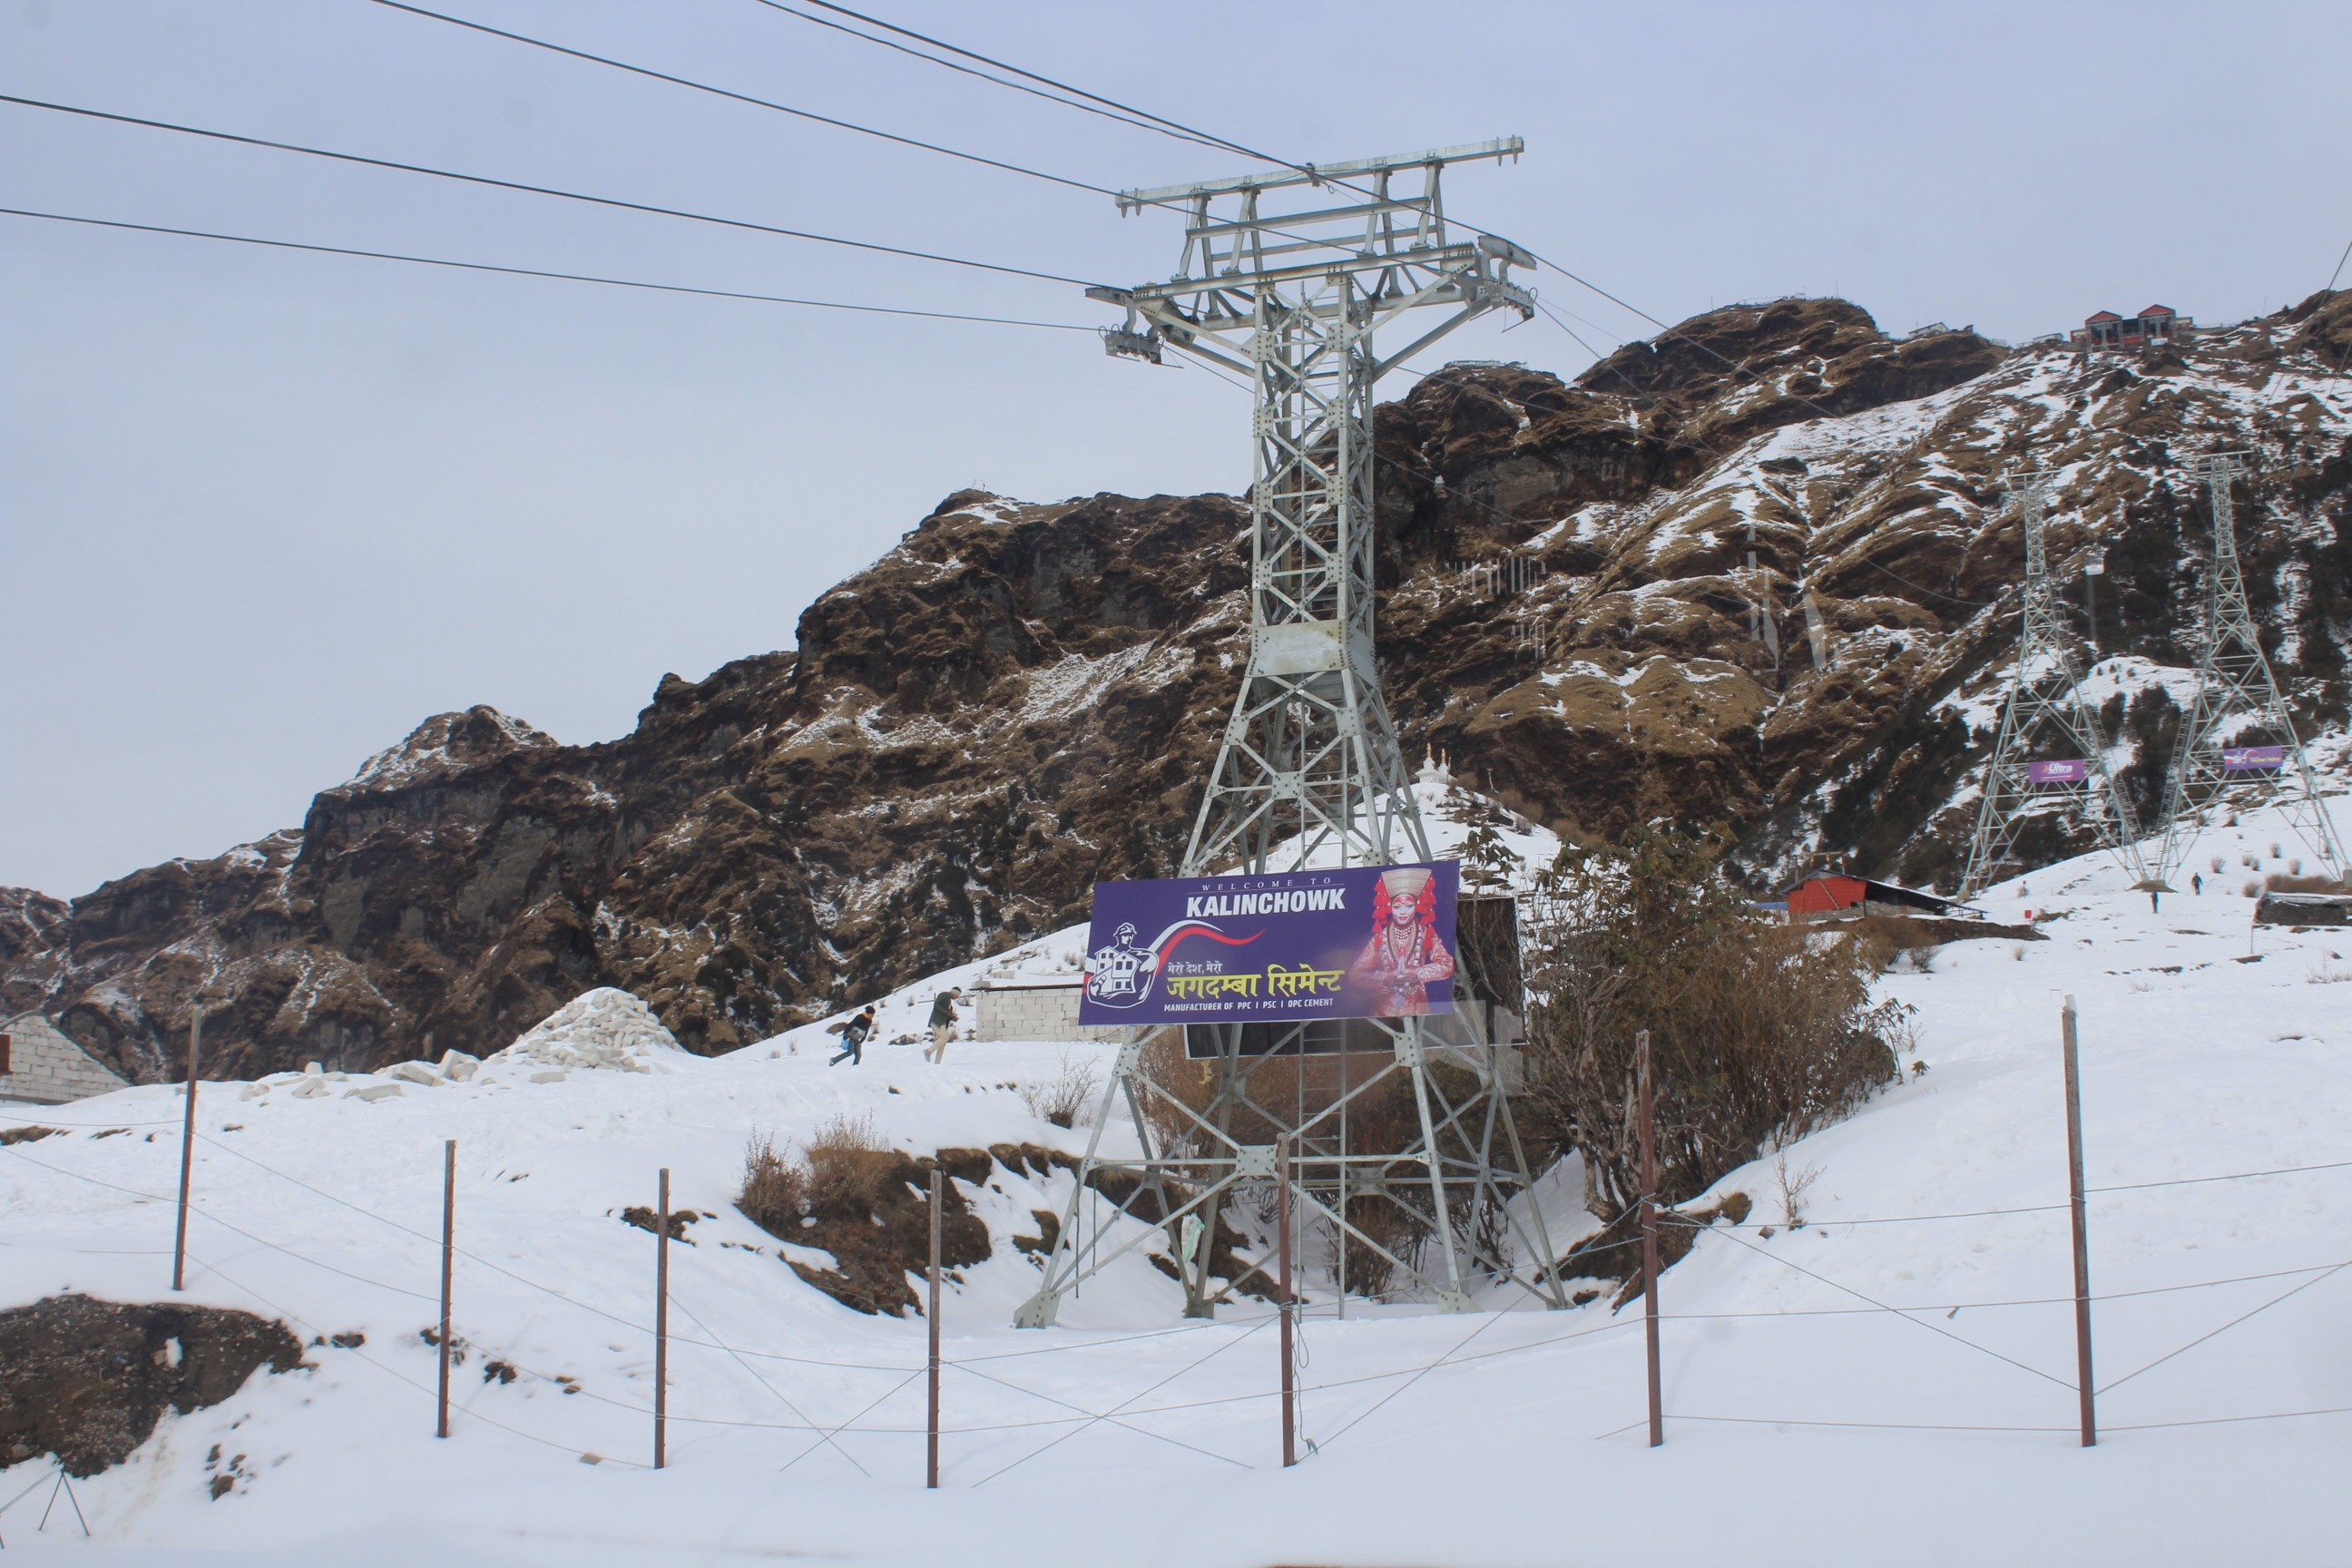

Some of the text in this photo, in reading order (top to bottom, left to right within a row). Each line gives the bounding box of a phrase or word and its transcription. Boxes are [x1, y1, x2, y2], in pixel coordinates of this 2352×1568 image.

[2048, 762, 2073, 772] Ultra
[1202, 879, 1293, 891] WELCOME
[1186, 888, 1346, 917] KALINCHOWK
[1168, 961, 1223, 975] मेरो देश, मेरो
[1167, 963, 1345, 999] जगदम्बा सिमेन्ट
[1164, 1003, 1221, 1012] MANUFACTURER
[1224, 1002, 1233, 1010] OF
[1238, 1002, 1251, 1010] PPC
[1263, 1001, 1277, 1009] PSC
[1304, 998, 1334, 1007] CEMENT
